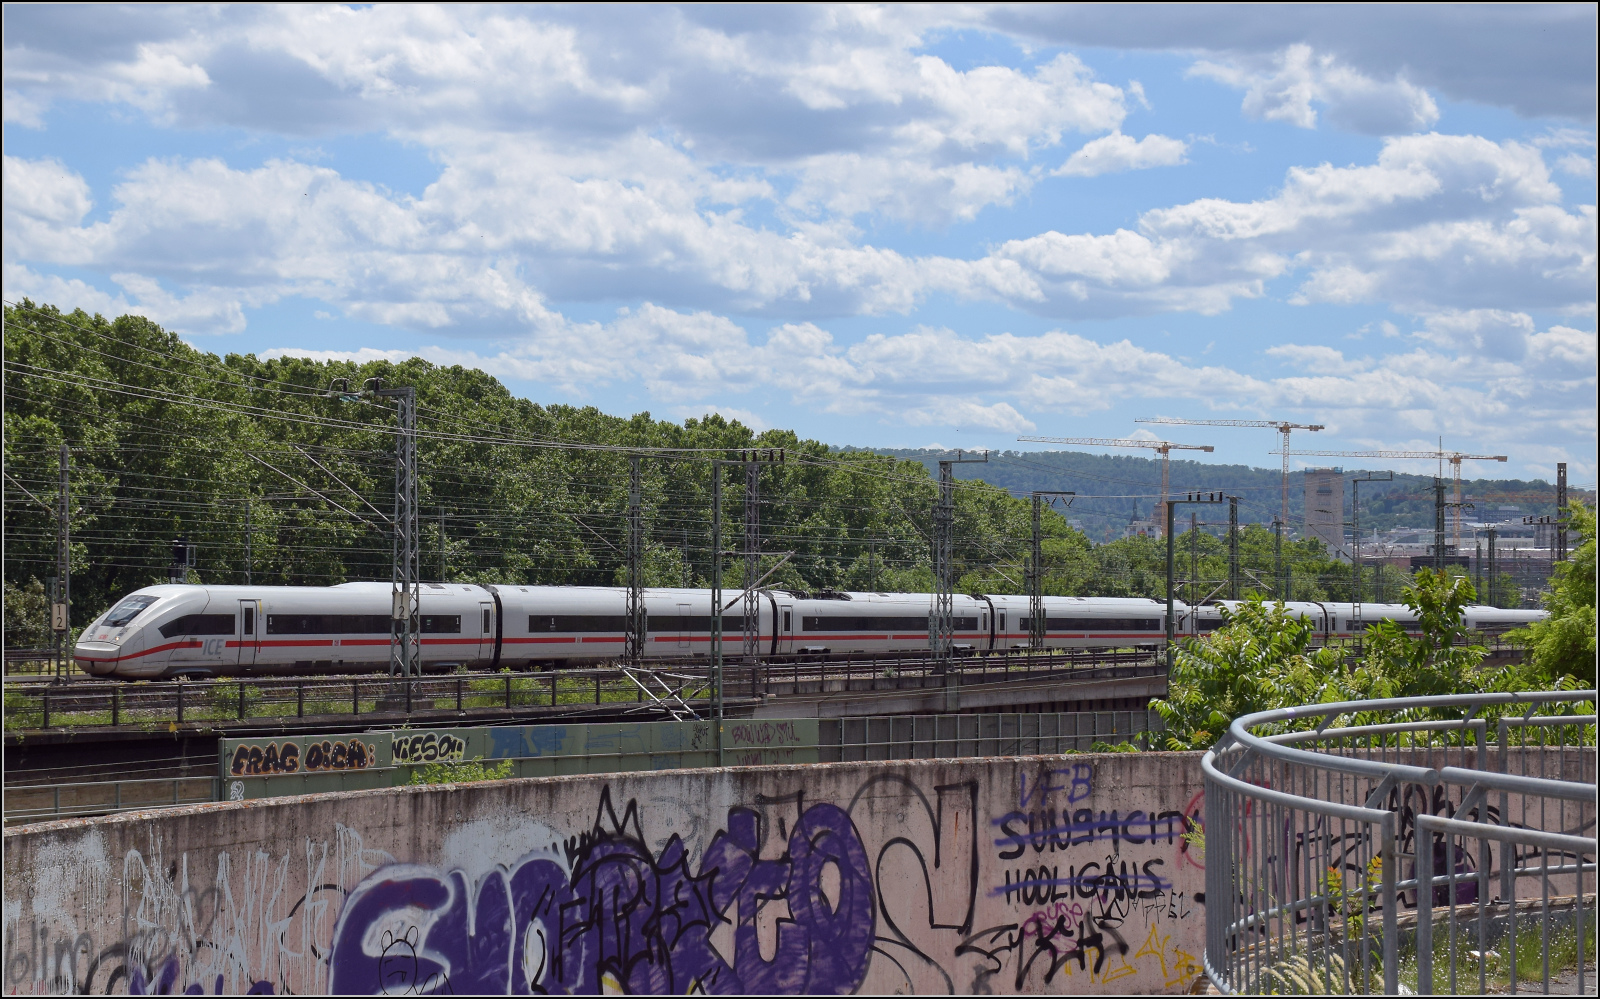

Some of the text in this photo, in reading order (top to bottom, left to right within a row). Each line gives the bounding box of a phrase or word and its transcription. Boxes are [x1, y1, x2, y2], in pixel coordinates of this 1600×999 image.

[57, 605, 61, 615] 1
[399, 606, 405, 617] 2
[57, 617, 62, 627] 2
[202, 639, 224, 656] ICE
[230, 741, 300, 776] FRAG
[1020, 763, 1092, 808] VFB
[1005, 858, 1164, 906] HOOLIGANS
